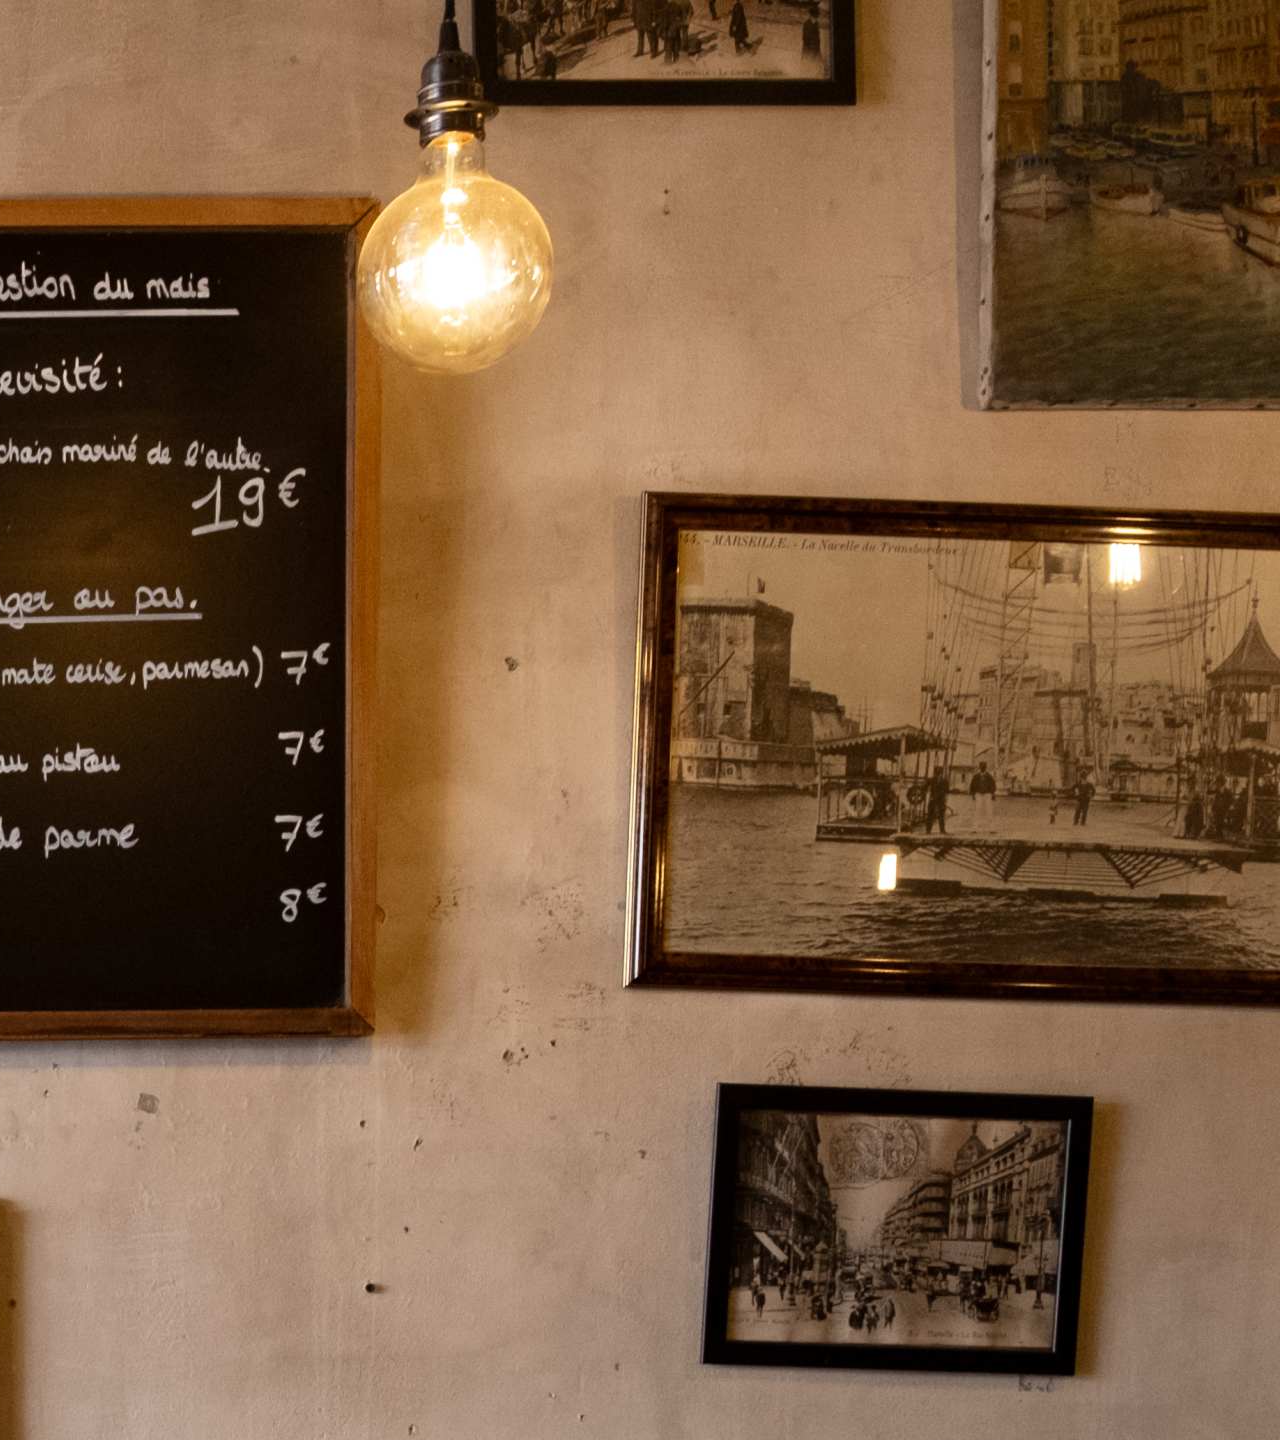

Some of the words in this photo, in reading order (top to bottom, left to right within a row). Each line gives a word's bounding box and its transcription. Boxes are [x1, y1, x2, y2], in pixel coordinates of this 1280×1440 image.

[92, 271, 135, 301] du
[61, 433, 139, 464] mariné
[146, 440, 173, 466] de
[43, 822, 140, 860] parme
